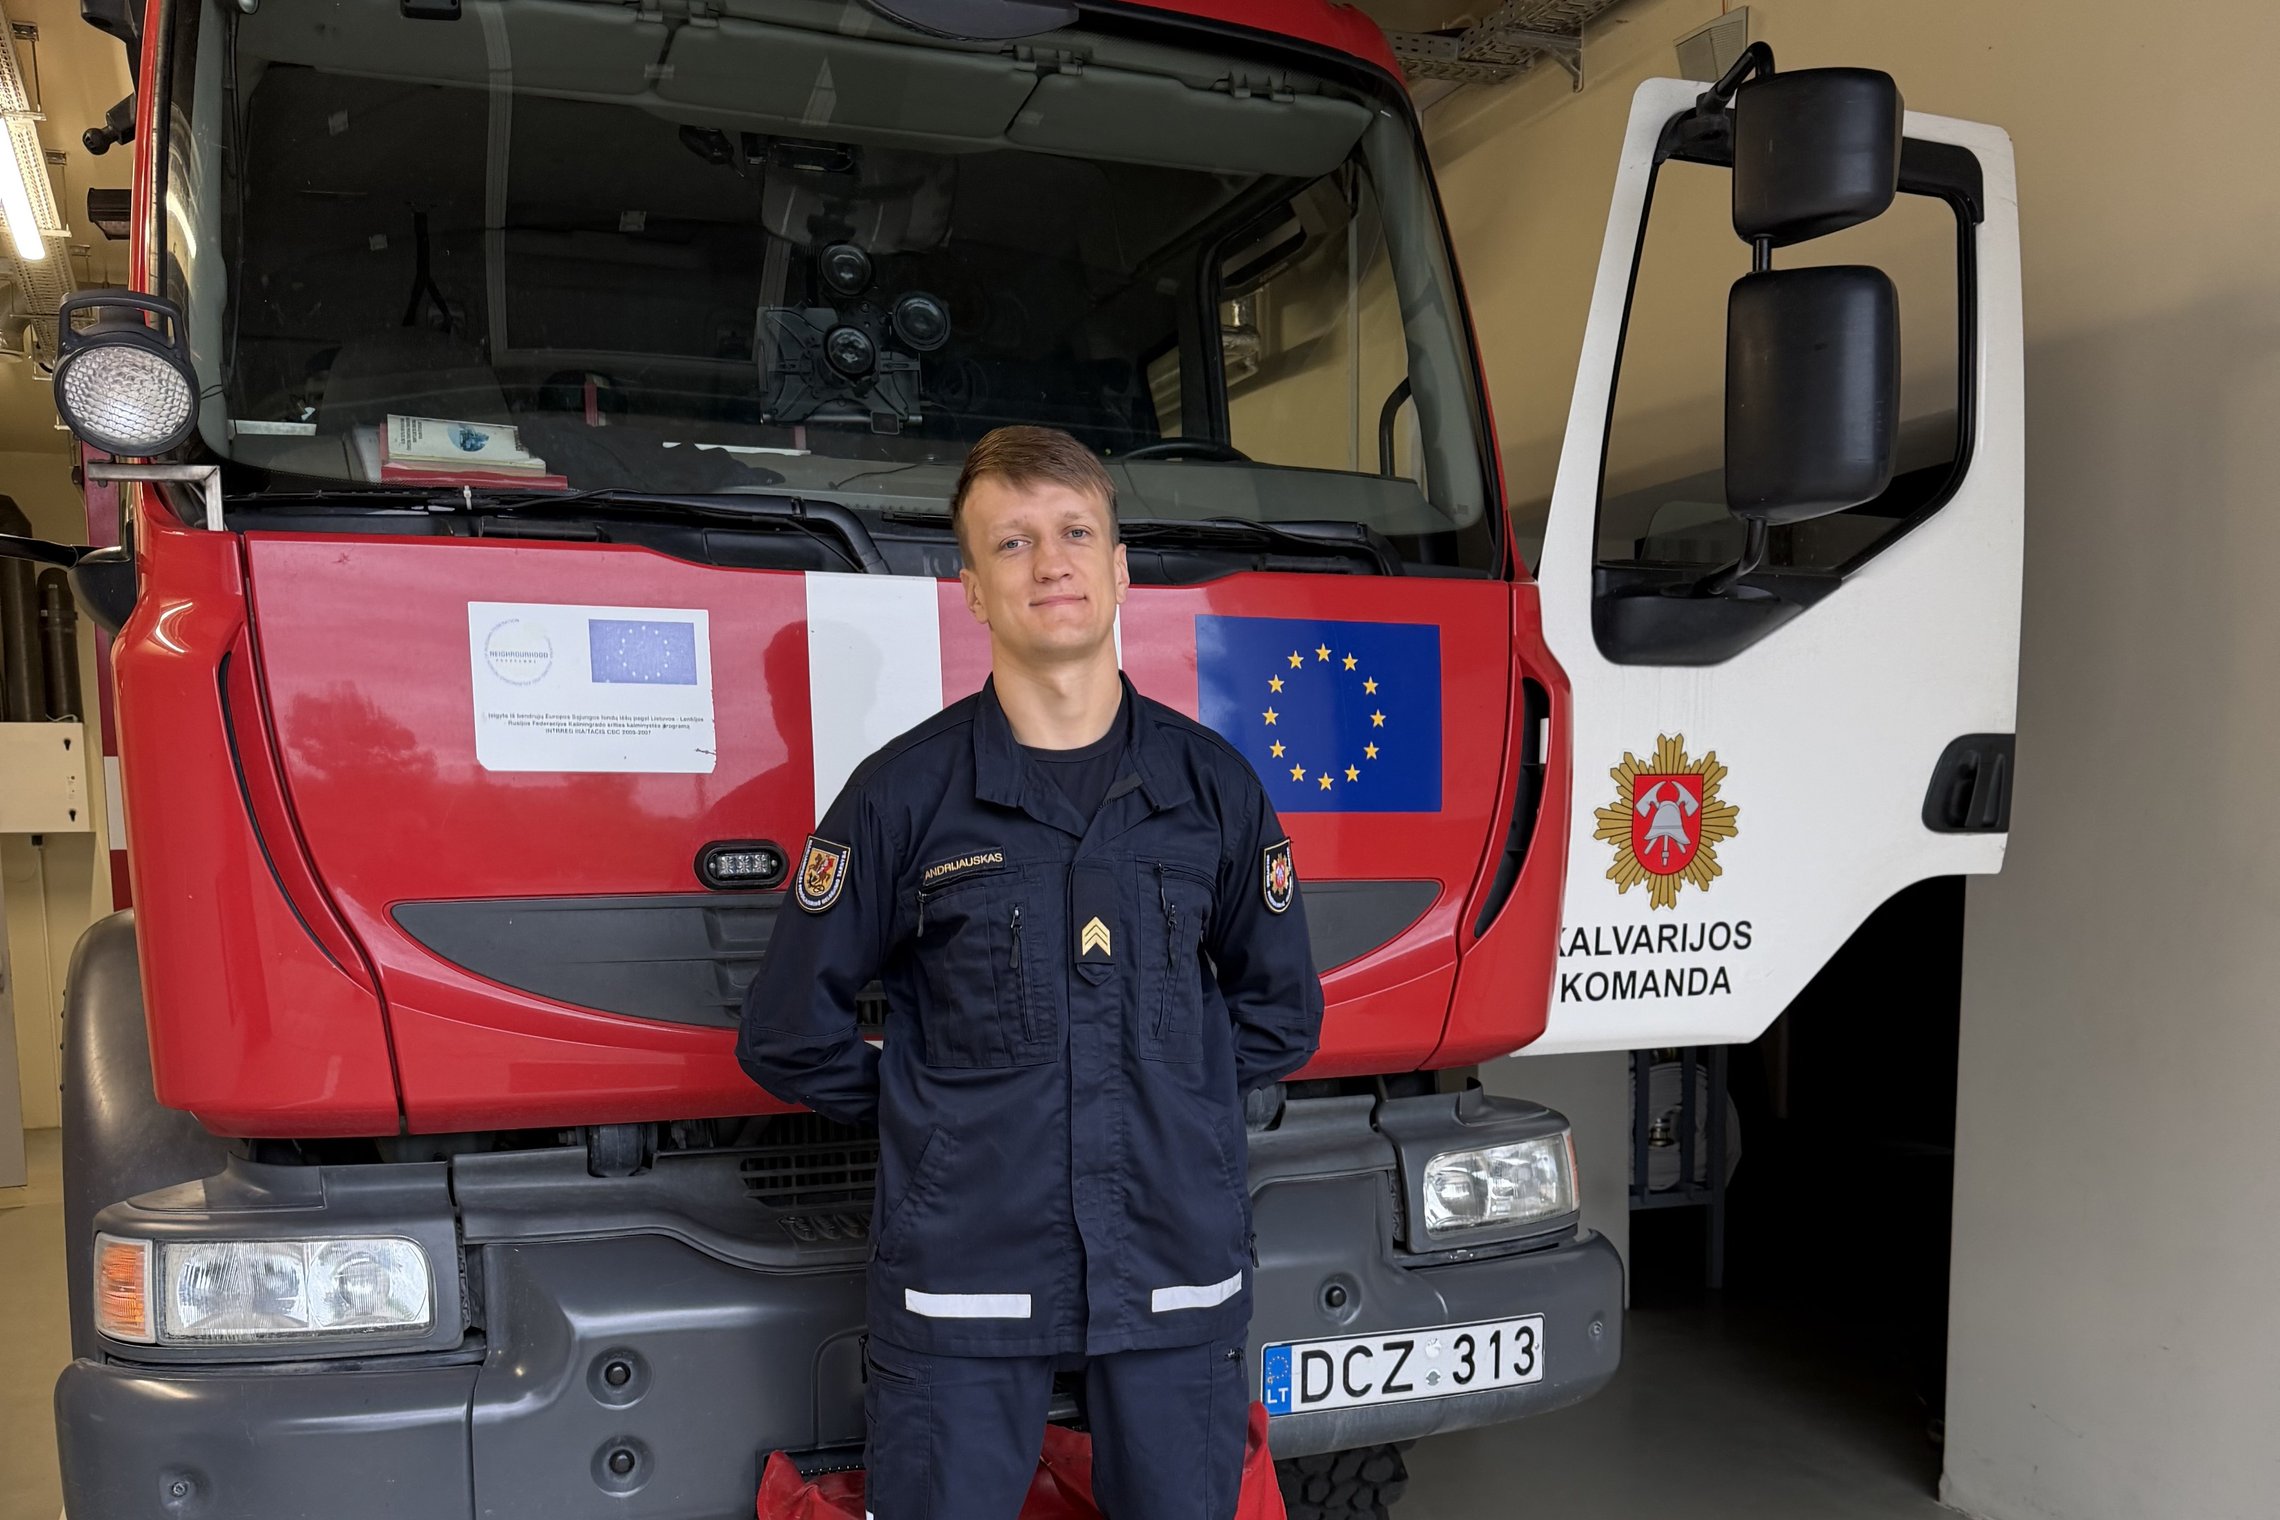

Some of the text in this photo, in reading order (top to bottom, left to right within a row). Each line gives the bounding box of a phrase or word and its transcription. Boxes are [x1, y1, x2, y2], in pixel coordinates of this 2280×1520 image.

[923, 852, 1004, 880] ANDRIJAUSKAS
[1560, 965, 1733, 1004] KOMANDA
[1266, 1325, 1536, 1405] LT DCZ 313
